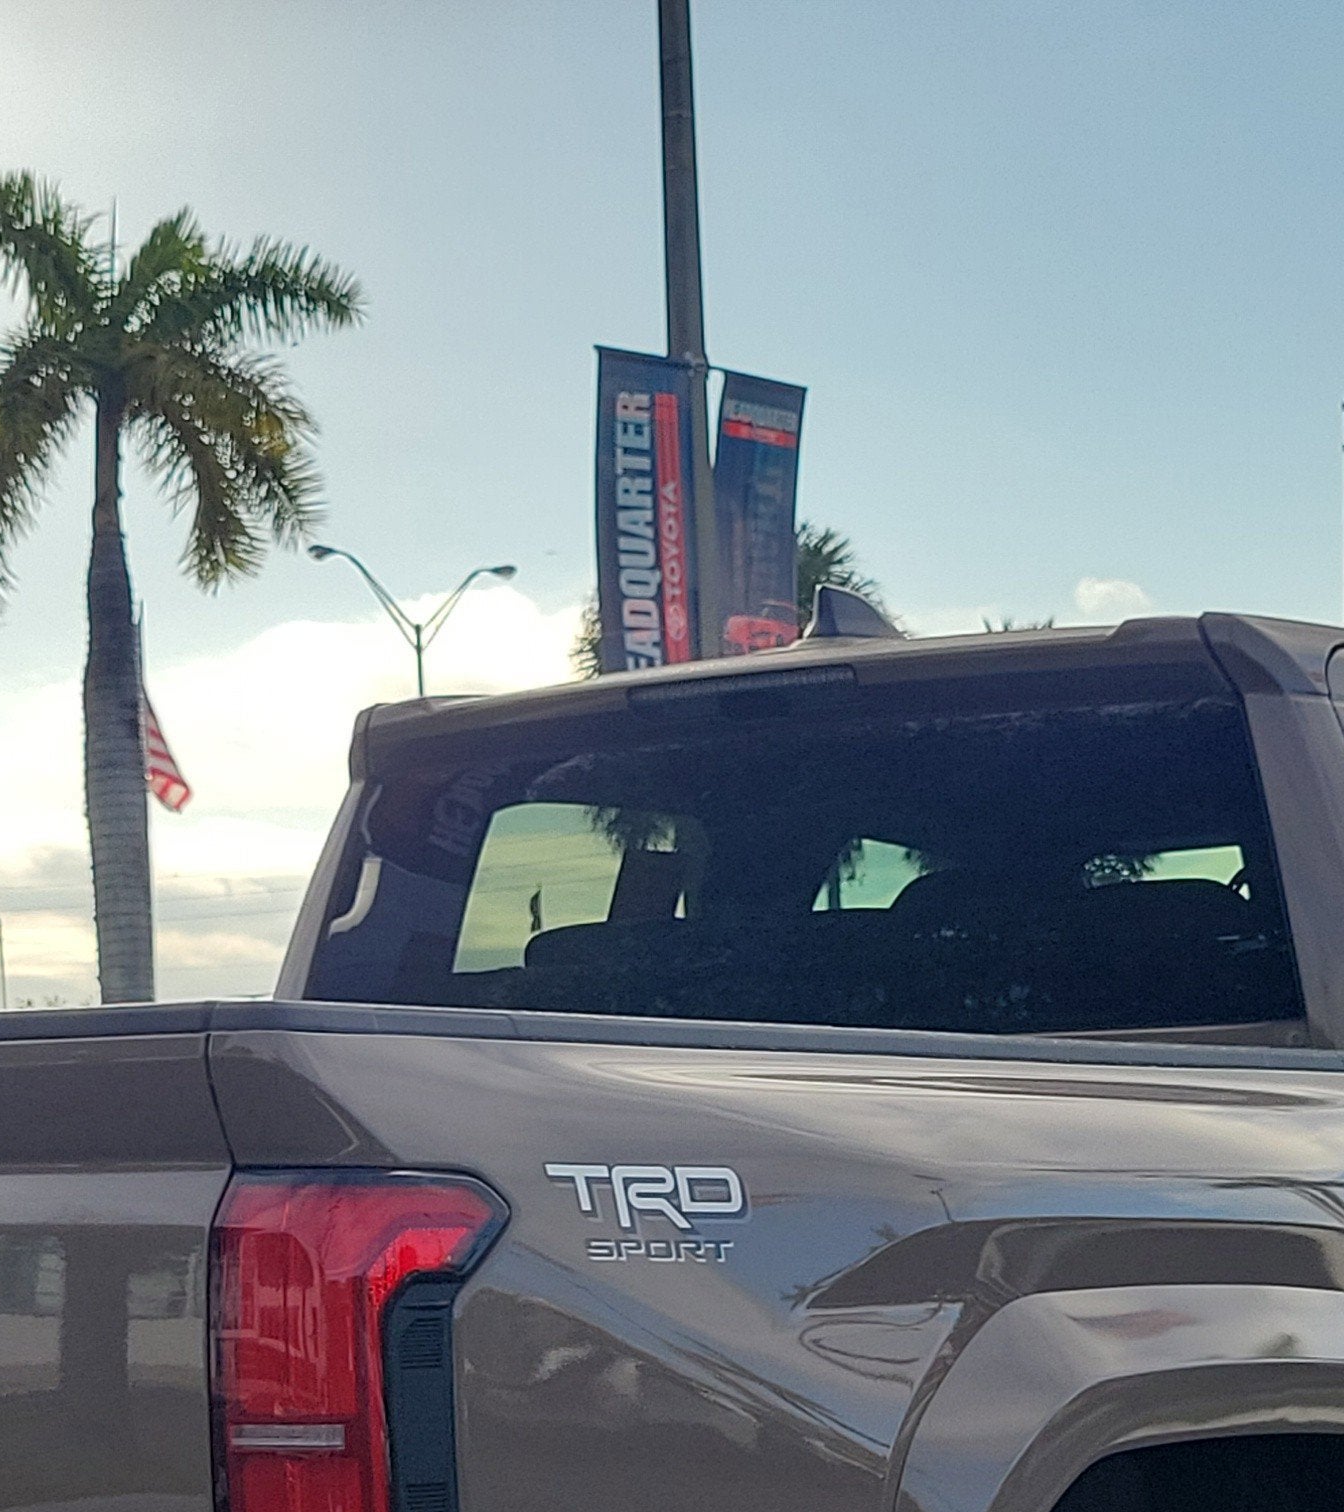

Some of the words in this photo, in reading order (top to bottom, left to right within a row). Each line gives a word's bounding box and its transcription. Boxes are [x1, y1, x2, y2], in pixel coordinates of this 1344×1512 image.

[615, 391, 662, 671] EADQUARTER
[659, 480, 683, 603] TOYOTA
[543, 1163, 744, 1230] TRD
[587, 1240, 734, 1264] SPORT
